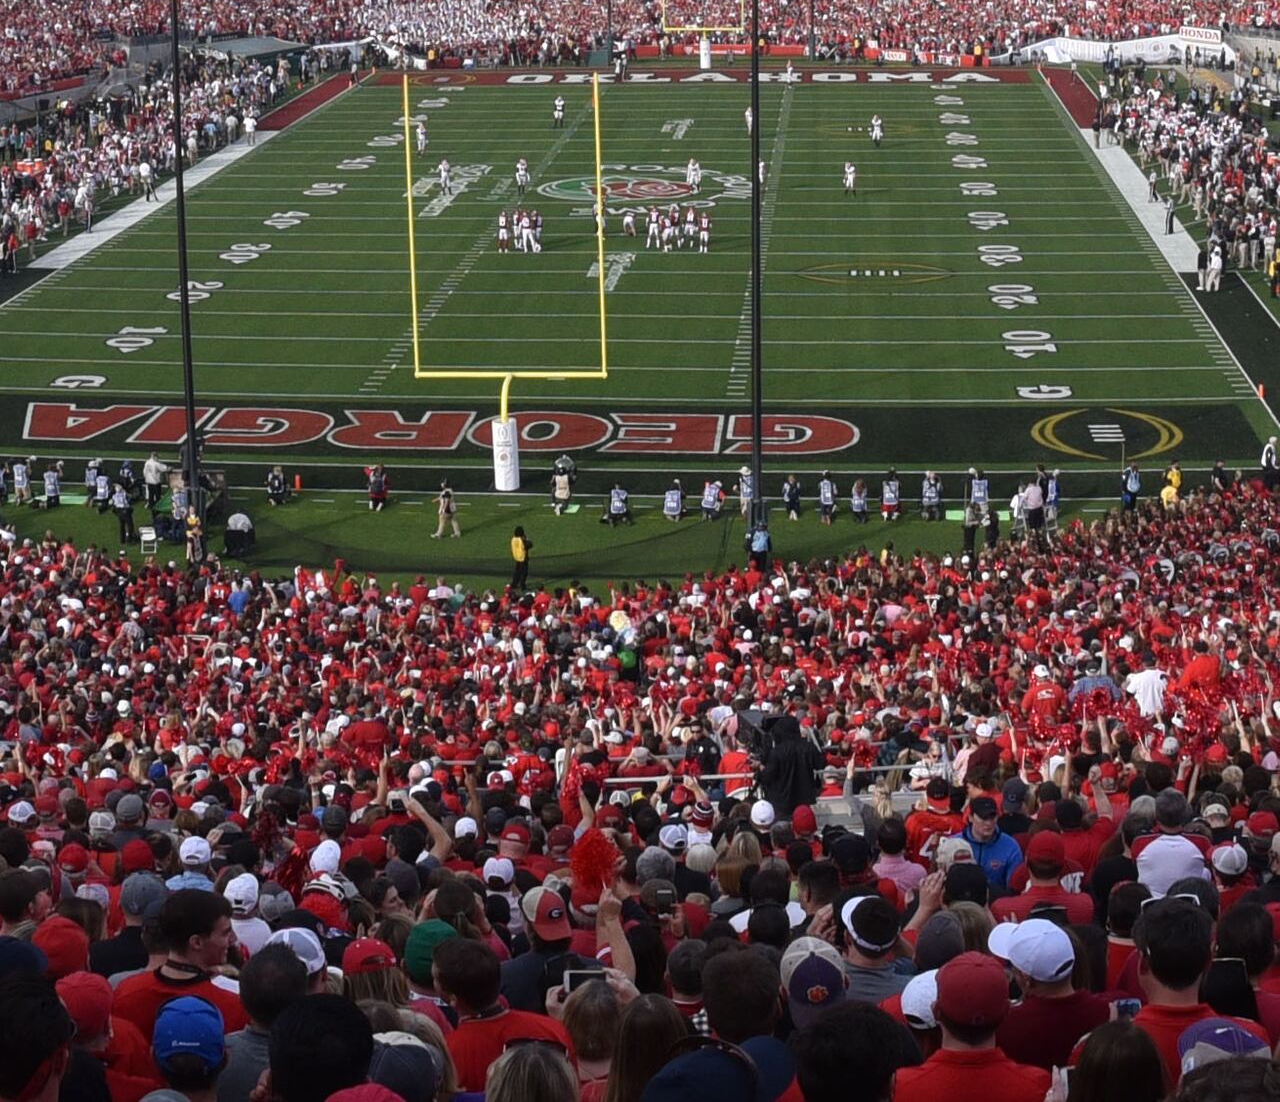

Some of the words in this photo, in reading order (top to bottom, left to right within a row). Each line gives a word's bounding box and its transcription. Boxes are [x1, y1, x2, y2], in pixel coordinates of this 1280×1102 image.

[1180, 28, 1220, 41] HONDA
[506, 72, 1001, 85] OKLAHOMA
[303, 182, 347, 196] 50
[959, 182, 998, 195] 50
[263, 210, 311, 227] 40
[967, 211, 1009, 228] 40
[219, 242, 272, 261] 30
[977, 244, 1023, 264] 30
[166, 281, 224, 300] 20
[988, 284, 1039, 307] 20
[106, 326, 168, 347] 10
[1001, 330, 1057, 354] 10
[50, 375, 107, 388] G
[1016, 384, 1073, 398] G
[22, 402, 860, 455] GEORGIA
